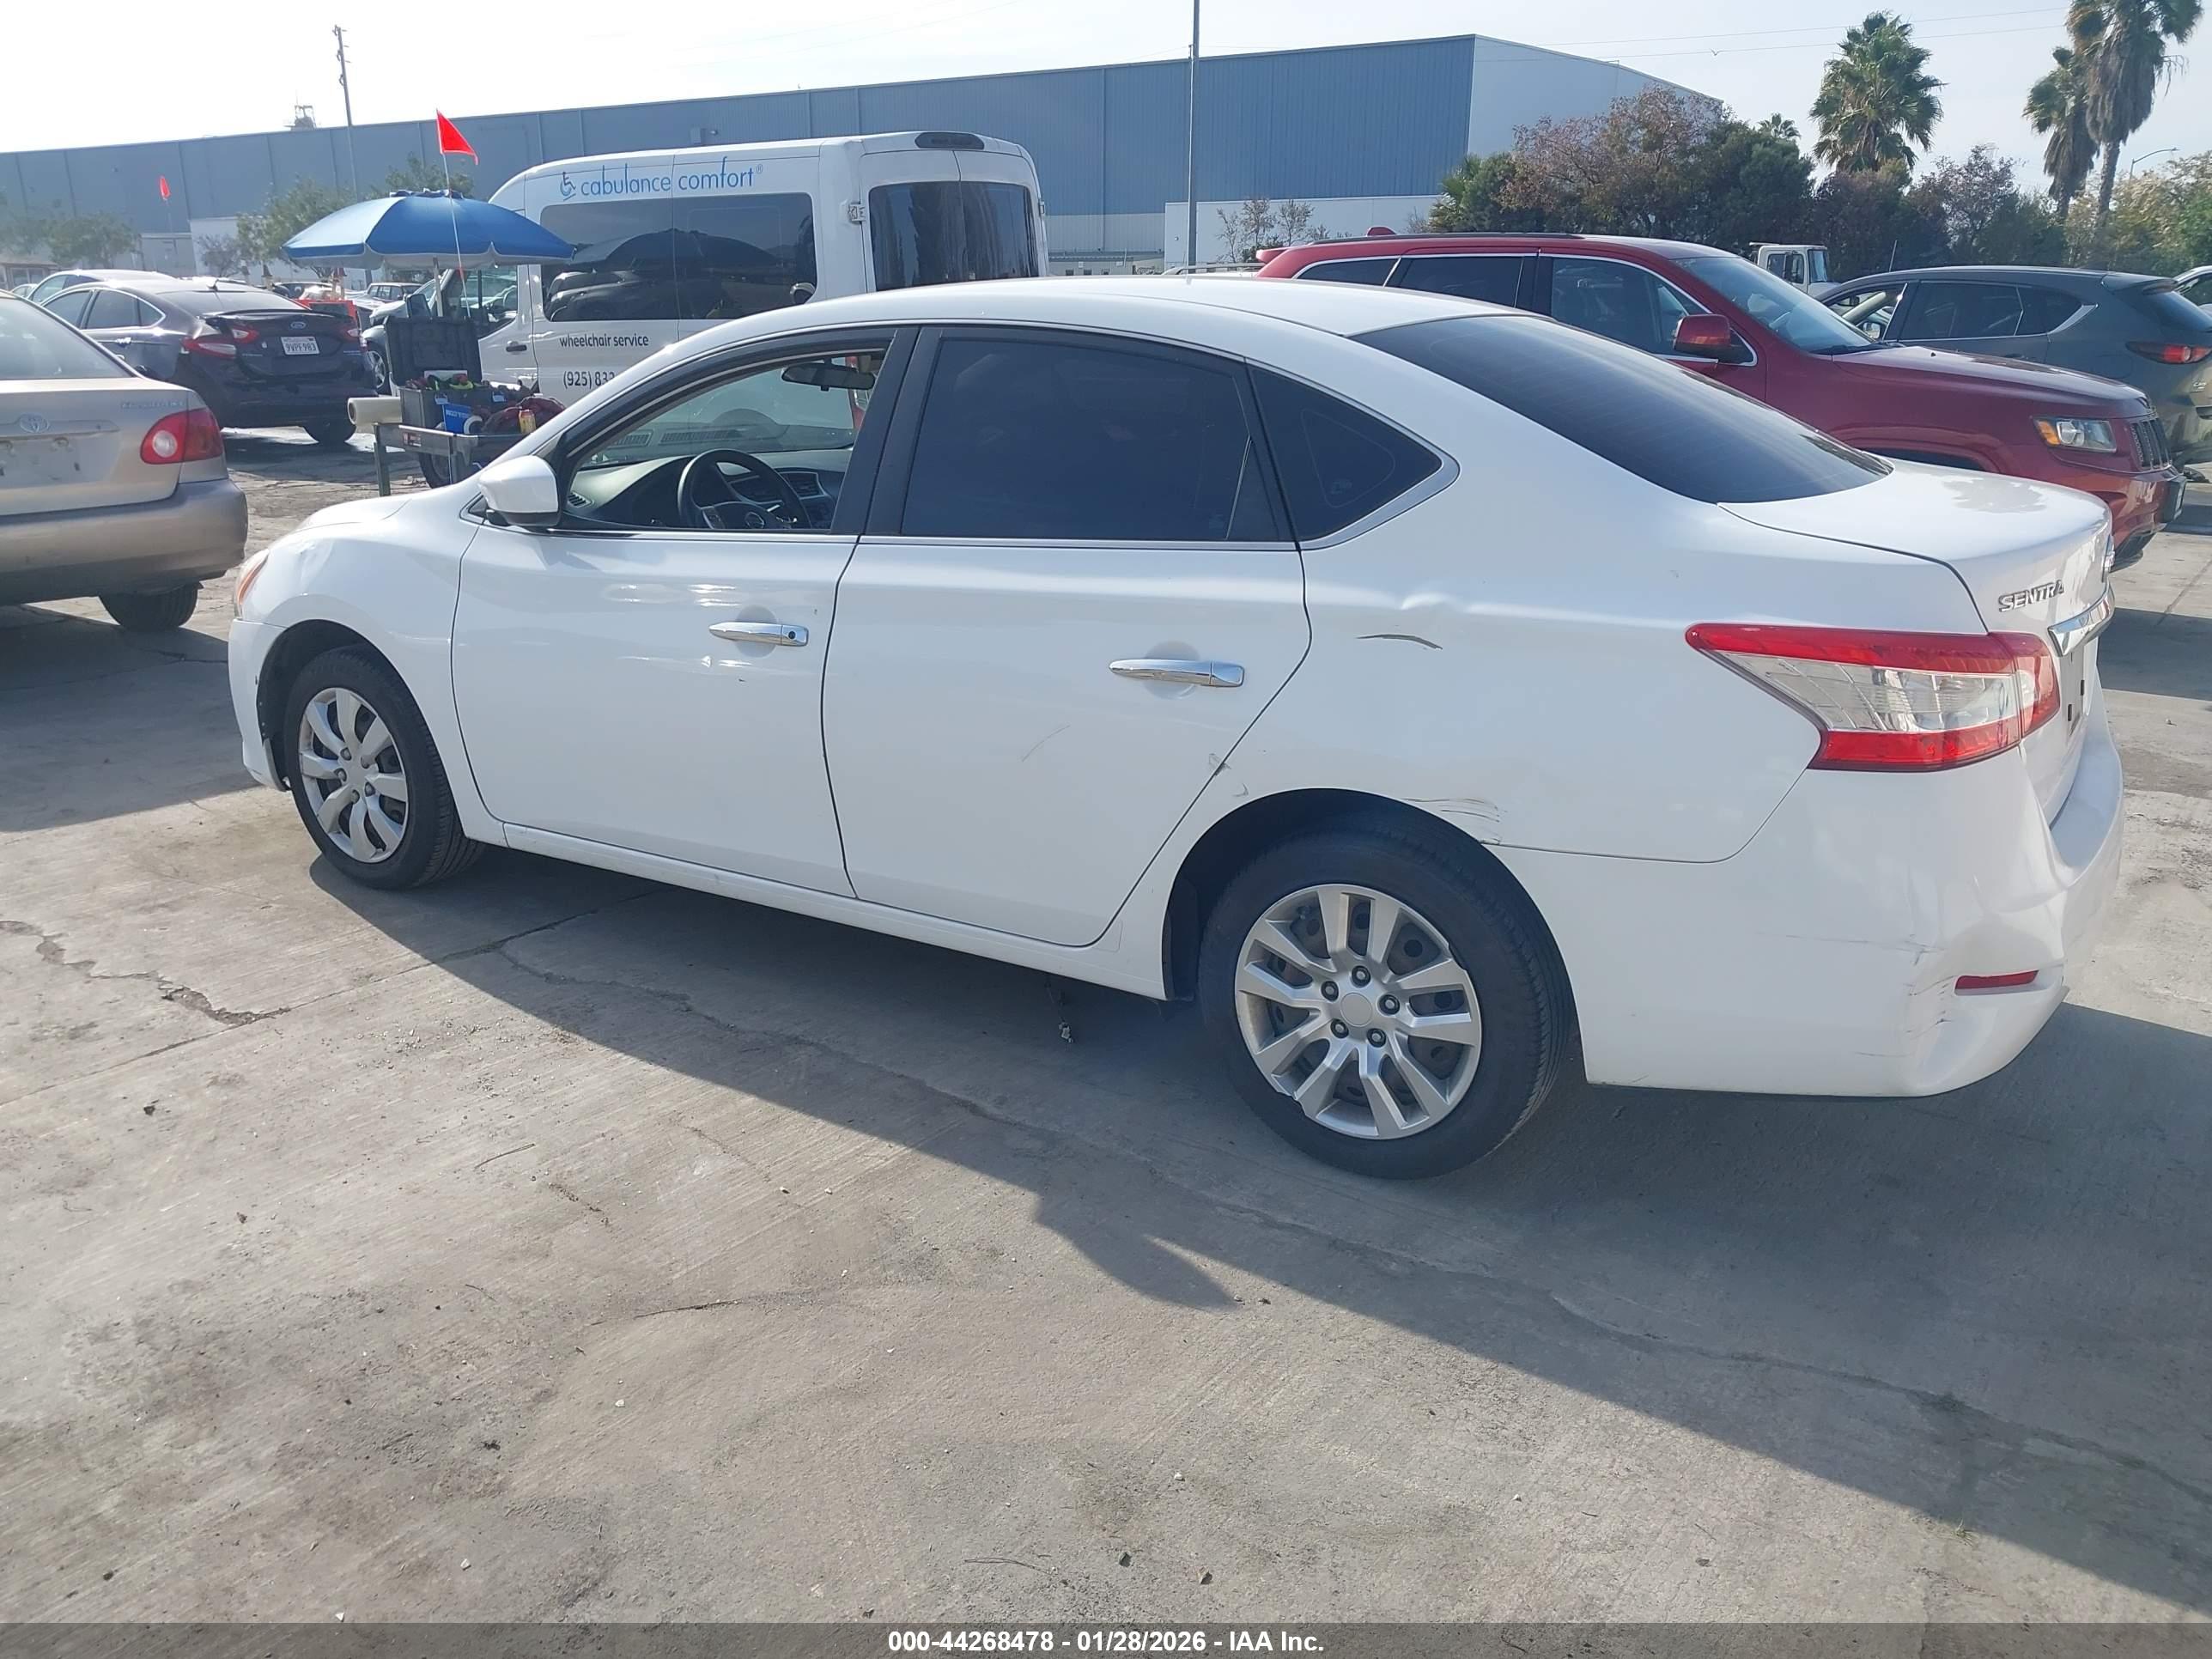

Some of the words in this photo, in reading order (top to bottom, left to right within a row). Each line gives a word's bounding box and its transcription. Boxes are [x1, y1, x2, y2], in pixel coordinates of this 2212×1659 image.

[580, 162, 672, 197] cabulance
[560, 332, 611, 347] wheelchair
[613, 332, 649, 347] service
[563, 371, 592, 389] (925)
[1998, 579, 2065, 612] SENTRA
